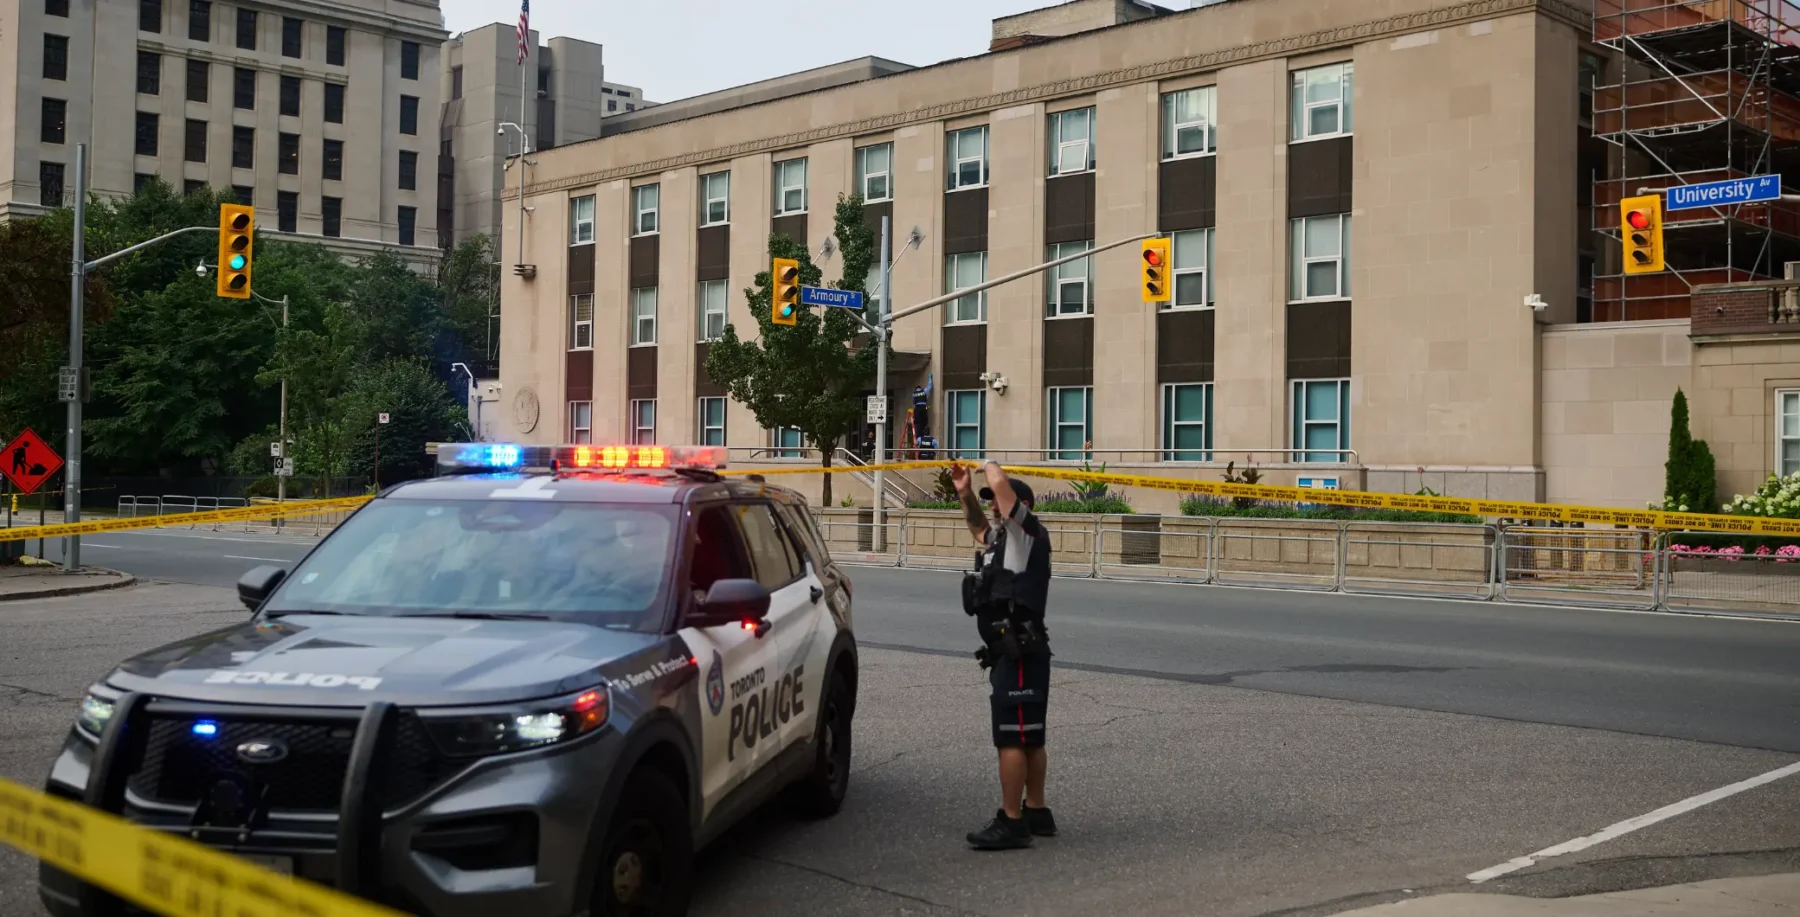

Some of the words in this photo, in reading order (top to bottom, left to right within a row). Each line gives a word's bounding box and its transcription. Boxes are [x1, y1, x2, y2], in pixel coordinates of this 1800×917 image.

[1675, 182, 1754, 204] University
[1760, 178, 1770, 186] Av
[810, 288, 848, 306] Armoury
[612, 679, 630, 692] To
[626, 670, 655, 686] Serve
[658, 654, 689, 674] Protect
[730, 666, 765, 701] TORONTO
[1008, 688, 1034, 697] POLICE
[728, 664, 804, 762] POLICE
